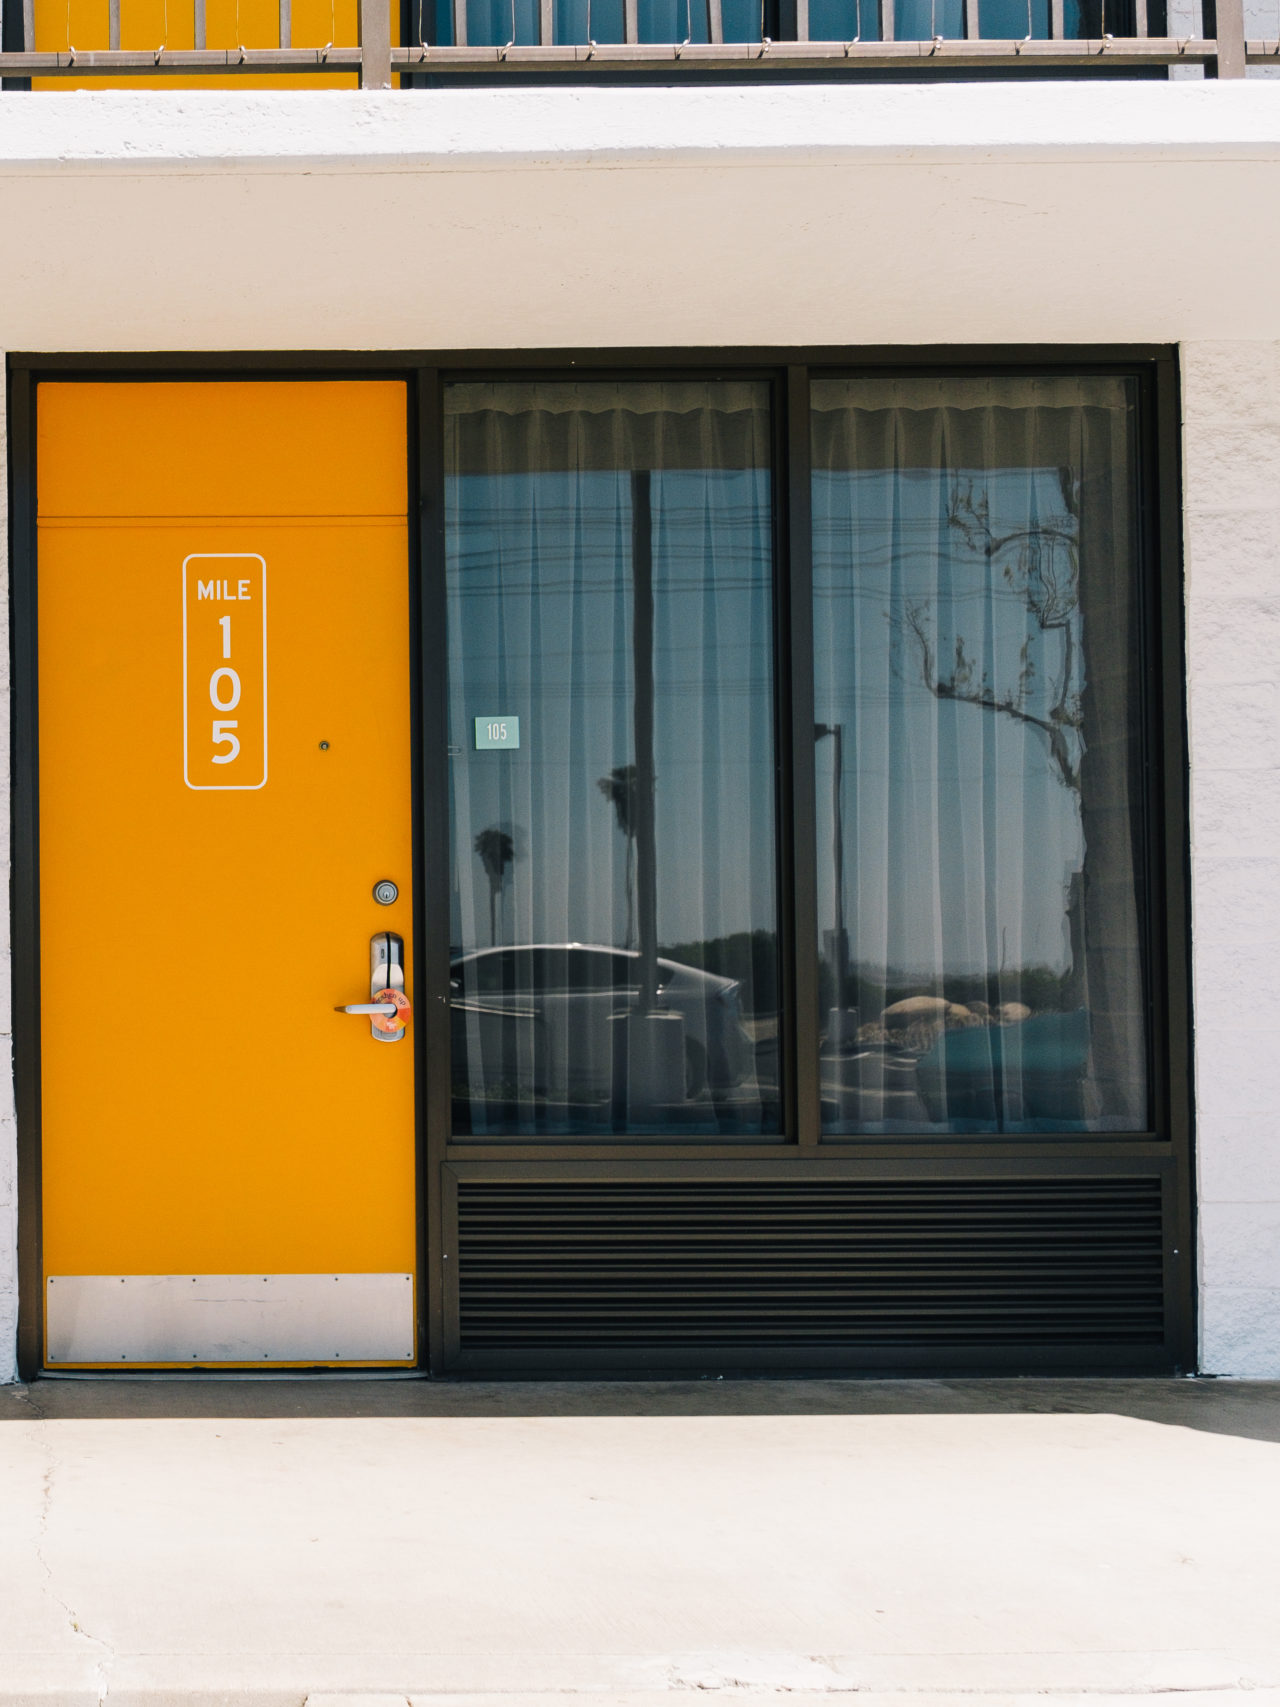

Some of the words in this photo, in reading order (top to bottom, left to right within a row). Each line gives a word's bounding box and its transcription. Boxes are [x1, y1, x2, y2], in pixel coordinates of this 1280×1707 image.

[197, 579, 252, 601] MILE
[209, 615, 242, 765] 105
[487, 723, 507, 740] 105
